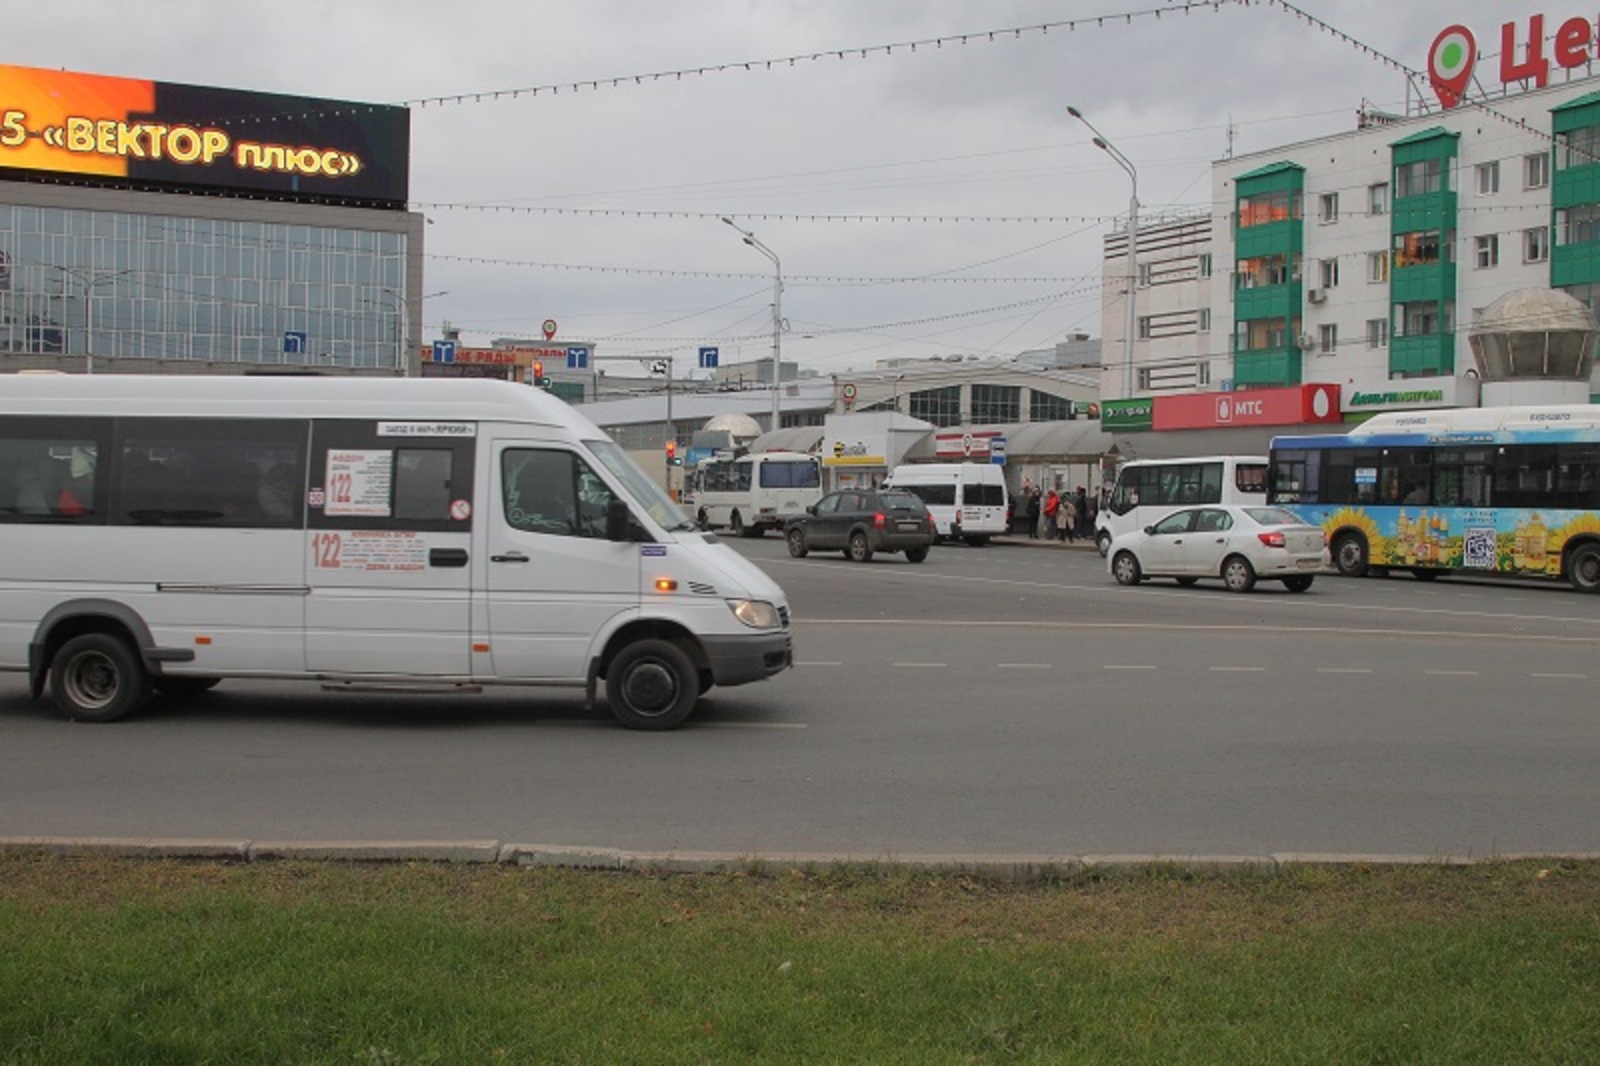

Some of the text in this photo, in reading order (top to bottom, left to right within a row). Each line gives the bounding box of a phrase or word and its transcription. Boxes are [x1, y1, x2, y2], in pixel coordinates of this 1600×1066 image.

[1500, 13, 1600, 88] Це
[237, 143, 359, 175] плюс»
[1235, 401, 1263, 415] МТС
[331, 473, 352, 502] 122
[312, 533, 341, 568] 122
